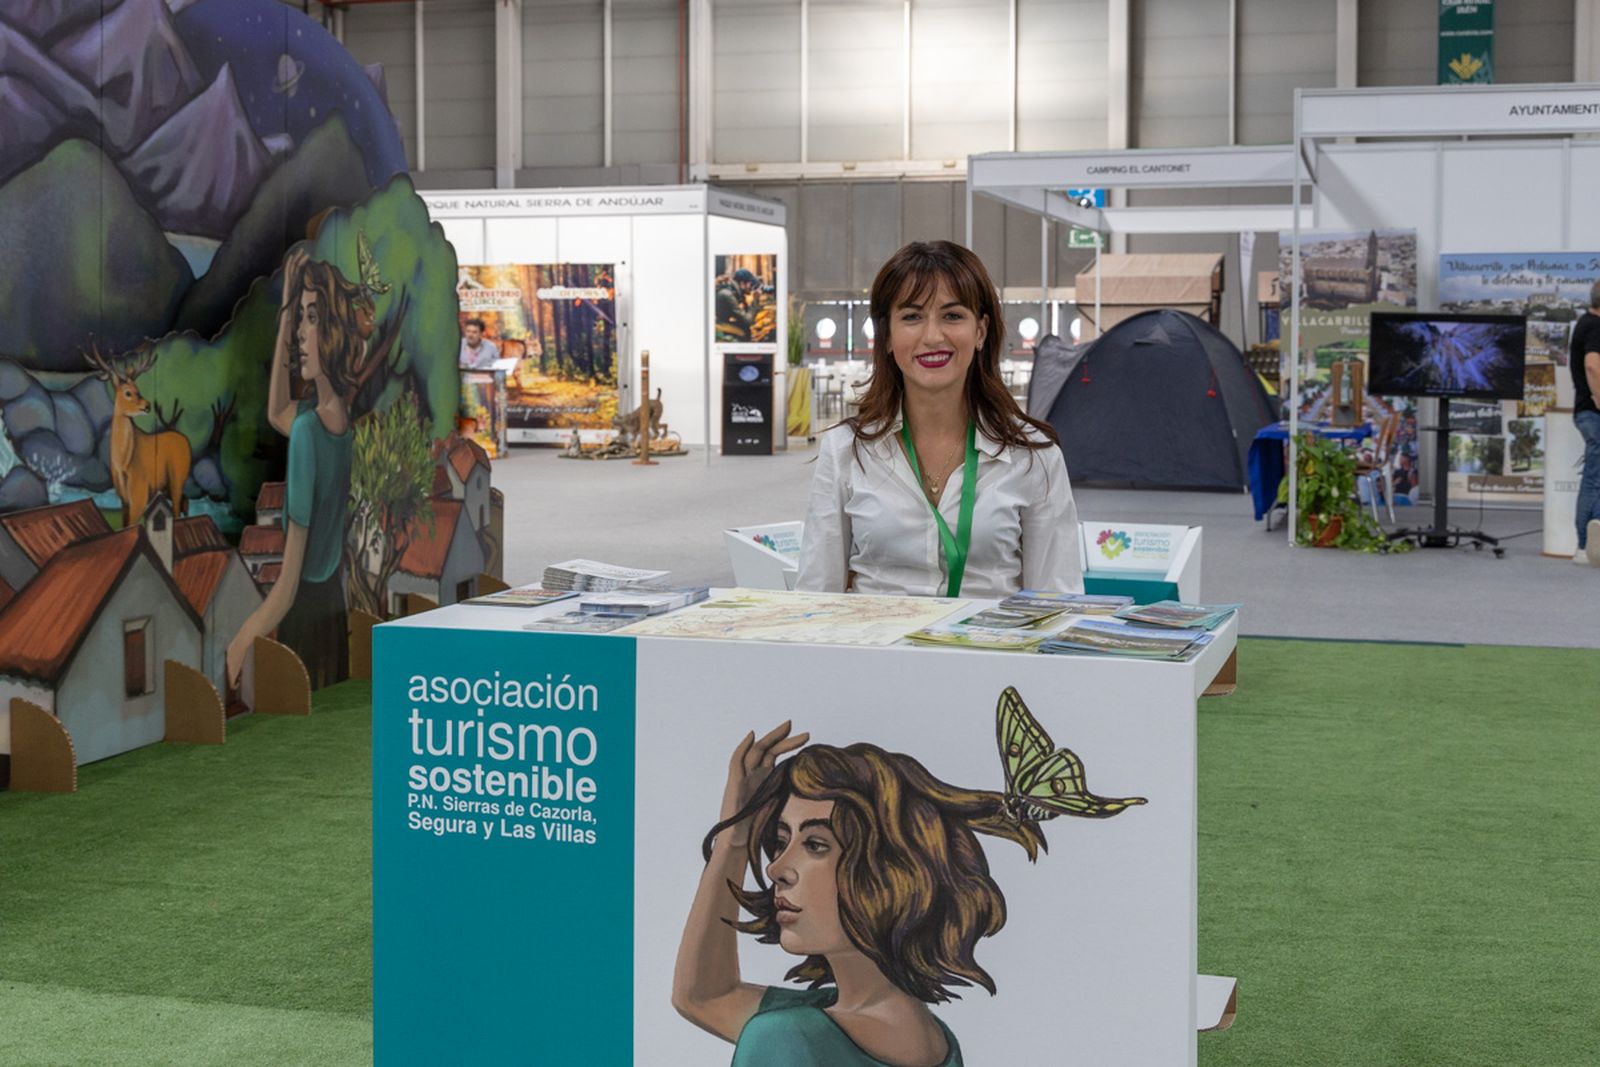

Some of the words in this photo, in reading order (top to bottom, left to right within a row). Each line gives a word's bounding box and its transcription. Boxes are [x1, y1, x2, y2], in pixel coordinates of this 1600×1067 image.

[1508, 103, 1600, 116] AYUNTAMIENT
[1086, 165, 1128, 175] CAMPING
[1129, 165, 1140, 174] EL
[1142, 163, 1191, 173] CANTONET
[464, 199, 521, 209] NATURAL
[526, 198, 571, 208] SIERRA
[575, 197, 594, 207] DE
[598, 195, 664, 207] ANDÚJAR
[1281, 315, 1370, 327] VLACARRILL
[408, 671, 598, 712] asociación
[408, 708, 598, 766] turismo
[408, 764, 597, 803] sostenible
[408, 793, 438, 809] P.N.
[442, 796, 500, 815] Sierras
[504, 801, 525, 817] de
[529, 802, 597, 826] Cazorla,
[408, 811, 477, 836] Segura
[482, 821, 494, 840] y
[500, 818, 536, 839] Las
[542, 821, 597, 845] Villas
